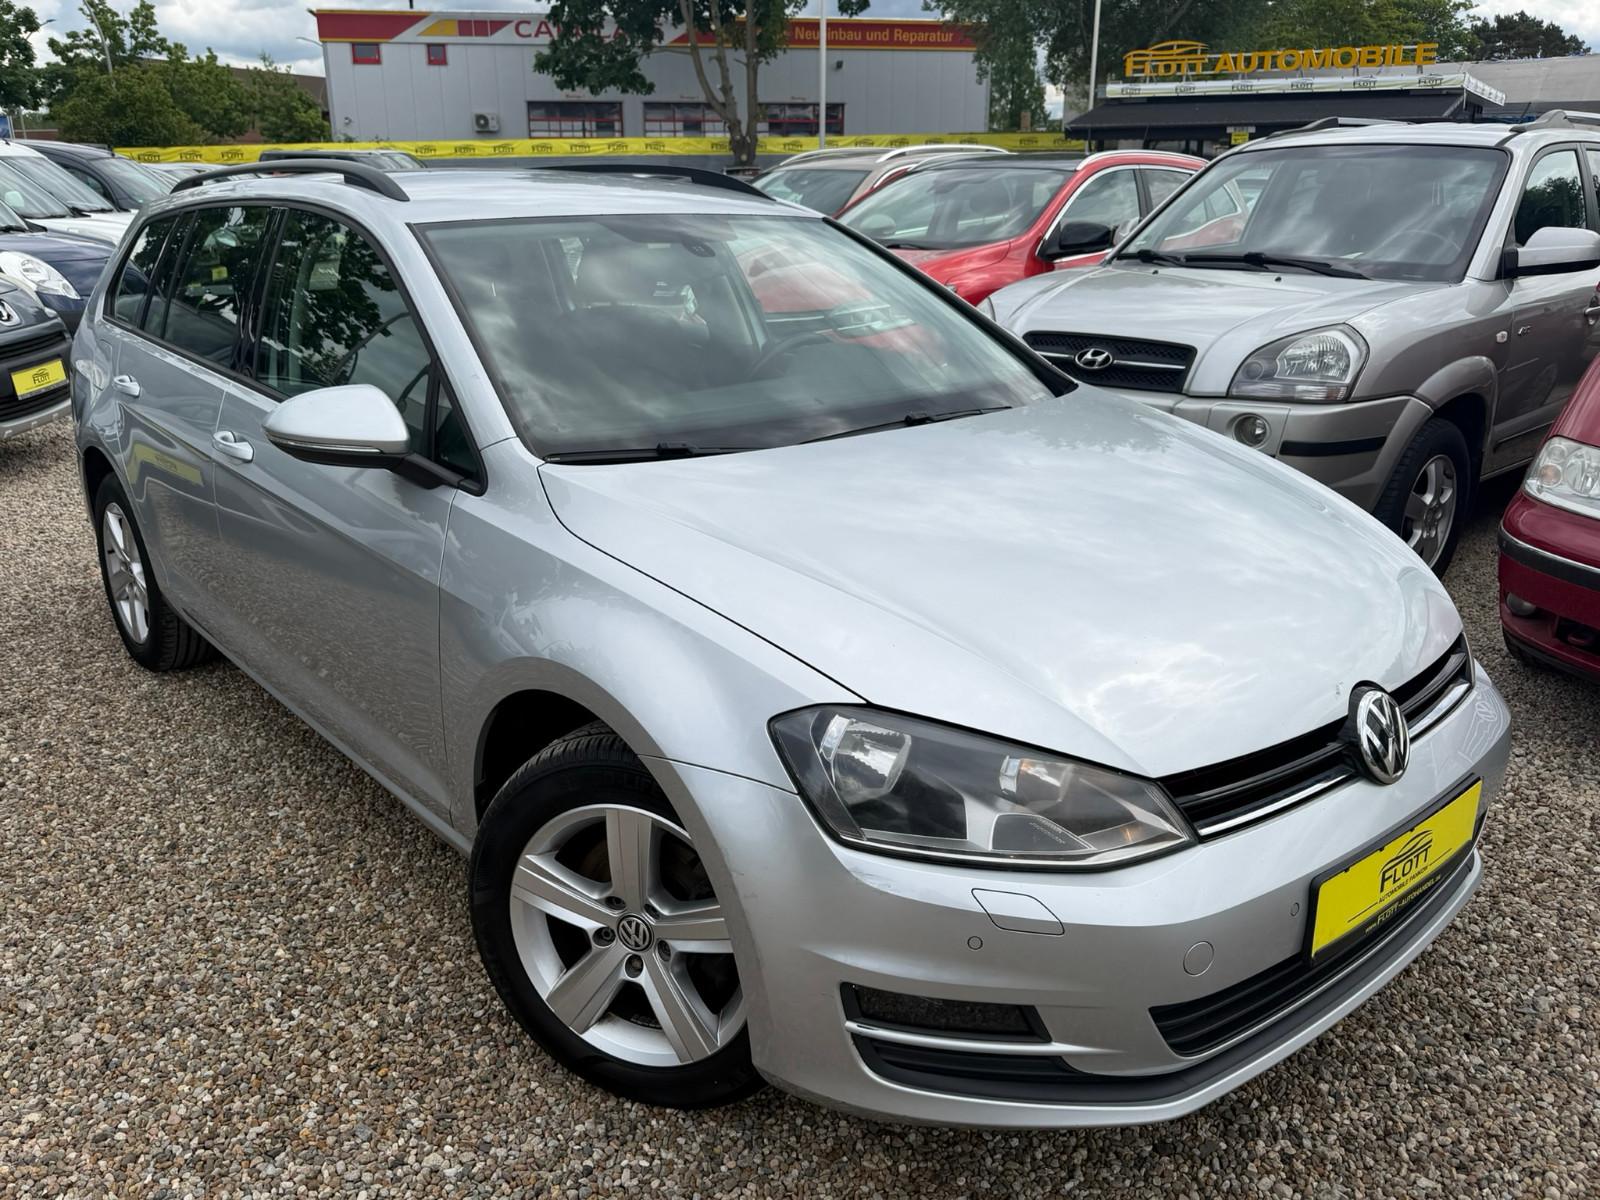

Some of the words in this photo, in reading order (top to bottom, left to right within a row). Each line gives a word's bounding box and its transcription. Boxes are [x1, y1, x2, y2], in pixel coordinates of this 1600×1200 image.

[795, 27, 862, 41] Neuinbau
[866, 28, 890, 41] und
[894, 28, 954, 44] Reparatur
[1124, 51, 1208, 77] FLOTT
[1214, 43, 1439, 73] AUTOMOBILE
[1379, 845, 1433, 893] FLOTT
